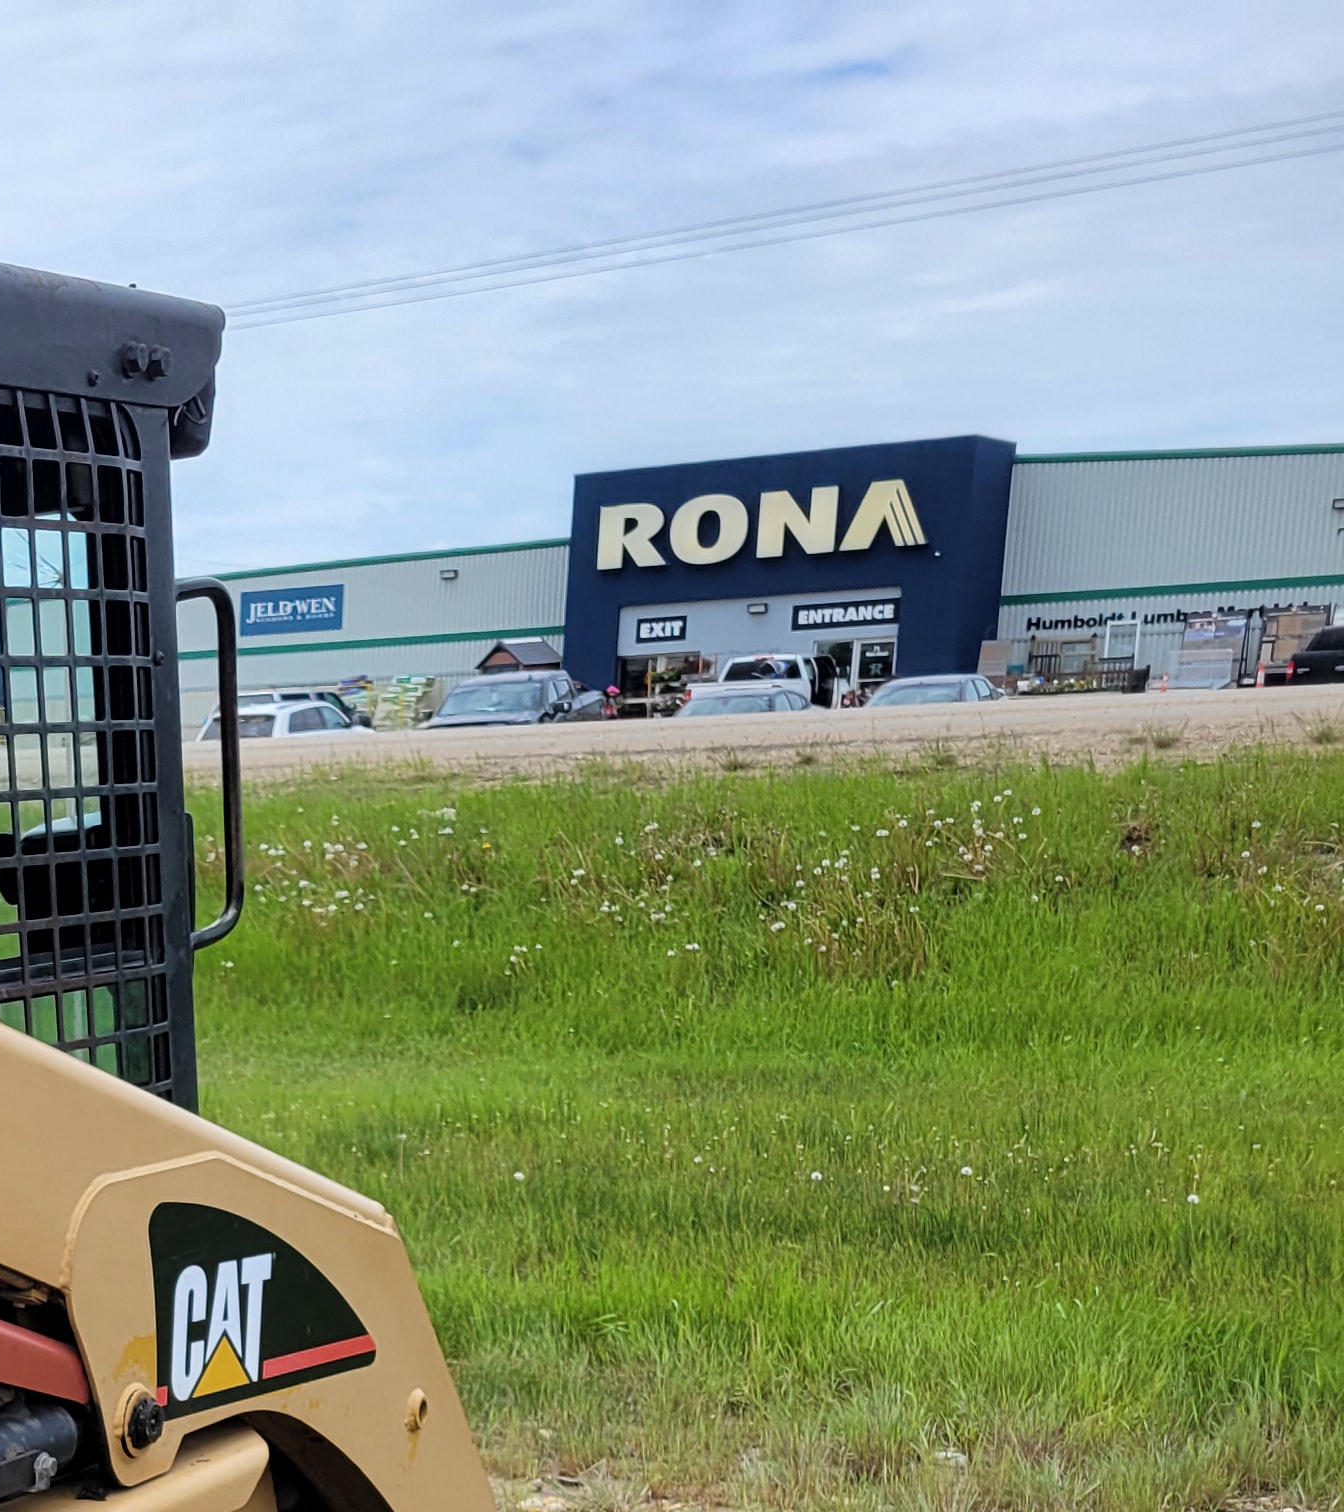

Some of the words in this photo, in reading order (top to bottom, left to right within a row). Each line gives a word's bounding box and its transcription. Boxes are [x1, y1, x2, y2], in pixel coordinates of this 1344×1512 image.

[596, 479, 929, 571] RONA
[639, 619, 684, 639] EXIT
[797, 604, 895, 625] ENTRANCE
[171, 1253, 273, 1401] CAT
